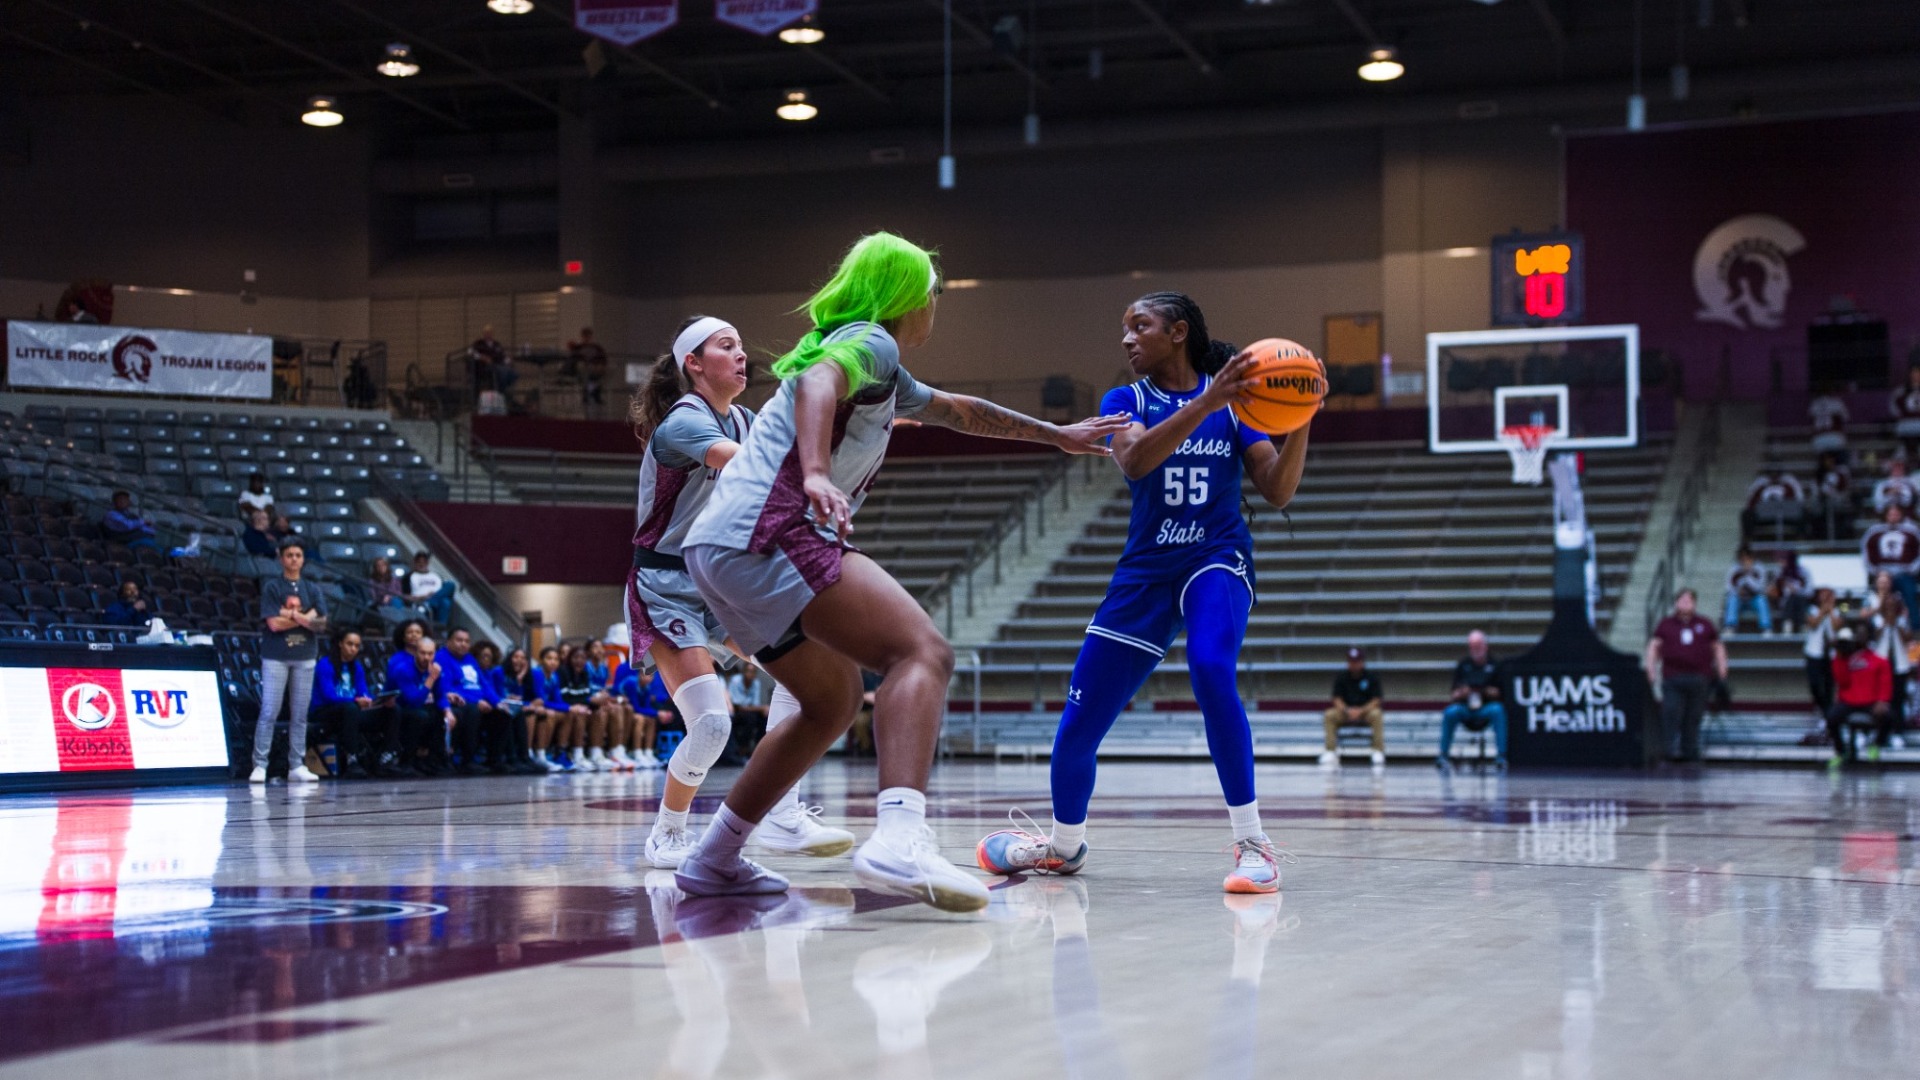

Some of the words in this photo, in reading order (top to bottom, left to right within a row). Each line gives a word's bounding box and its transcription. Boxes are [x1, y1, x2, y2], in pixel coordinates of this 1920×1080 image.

[1525, 273, 1565, 318] 10
[16, 347, 64, 361] LITTLE
[68, 350, 108, 363] ROCK
[160, 355, 213, 370] TROJAN
[217, 358, 266, 372] LEGION
[1266, 375, 1321, 395] Wilson
[1164, 466, 1209, 506] 55
[1156, 518, 1205, 545] State
[131, 690, 188, 718] RVT
[1513, 675, 1613, 706] UAMS
[1528, 704, 1626, 732] Health
[63, 737, 127, 756] Kubota
